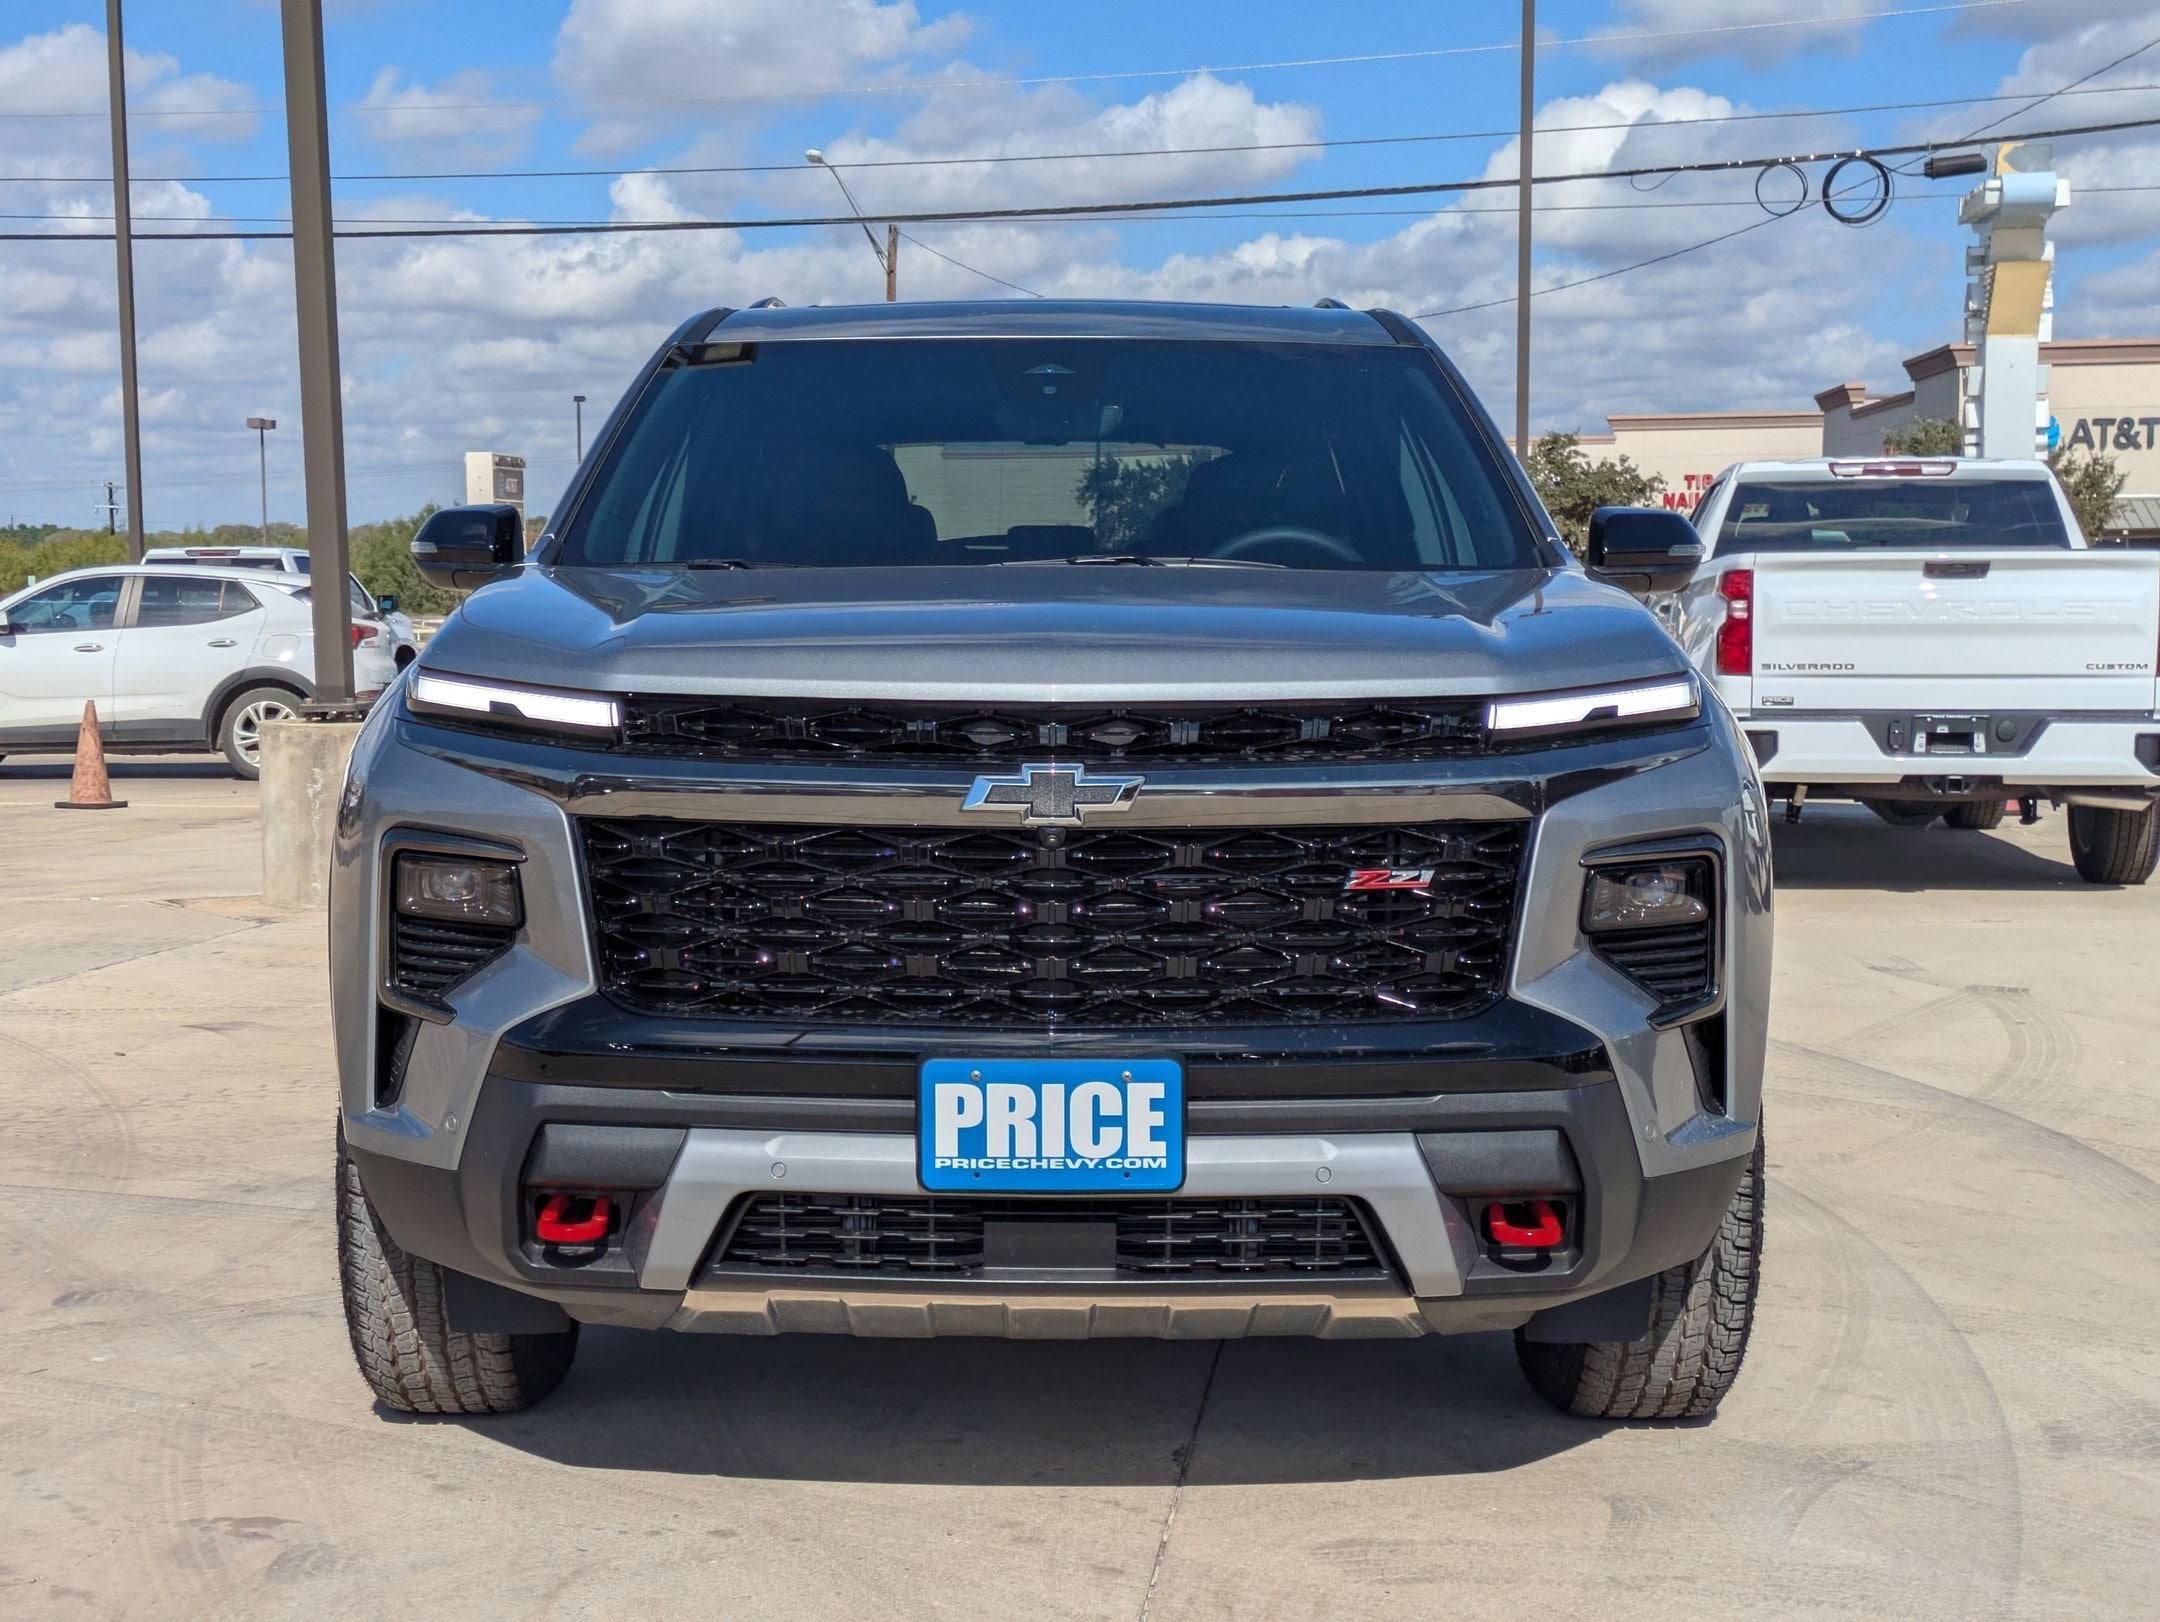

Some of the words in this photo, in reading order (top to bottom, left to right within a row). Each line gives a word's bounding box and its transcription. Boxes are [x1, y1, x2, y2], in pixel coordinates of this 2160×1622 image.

[2067, 417, 2160, 450] AT&T
[1782, 599, 2133, 620] CHEVROLET
[1344, 869, 1436, 889] Z71
[935, 1081, 1167, 1159] PRICE
[935, 1157, 1167, 1169] PRICECHEVY.COM
